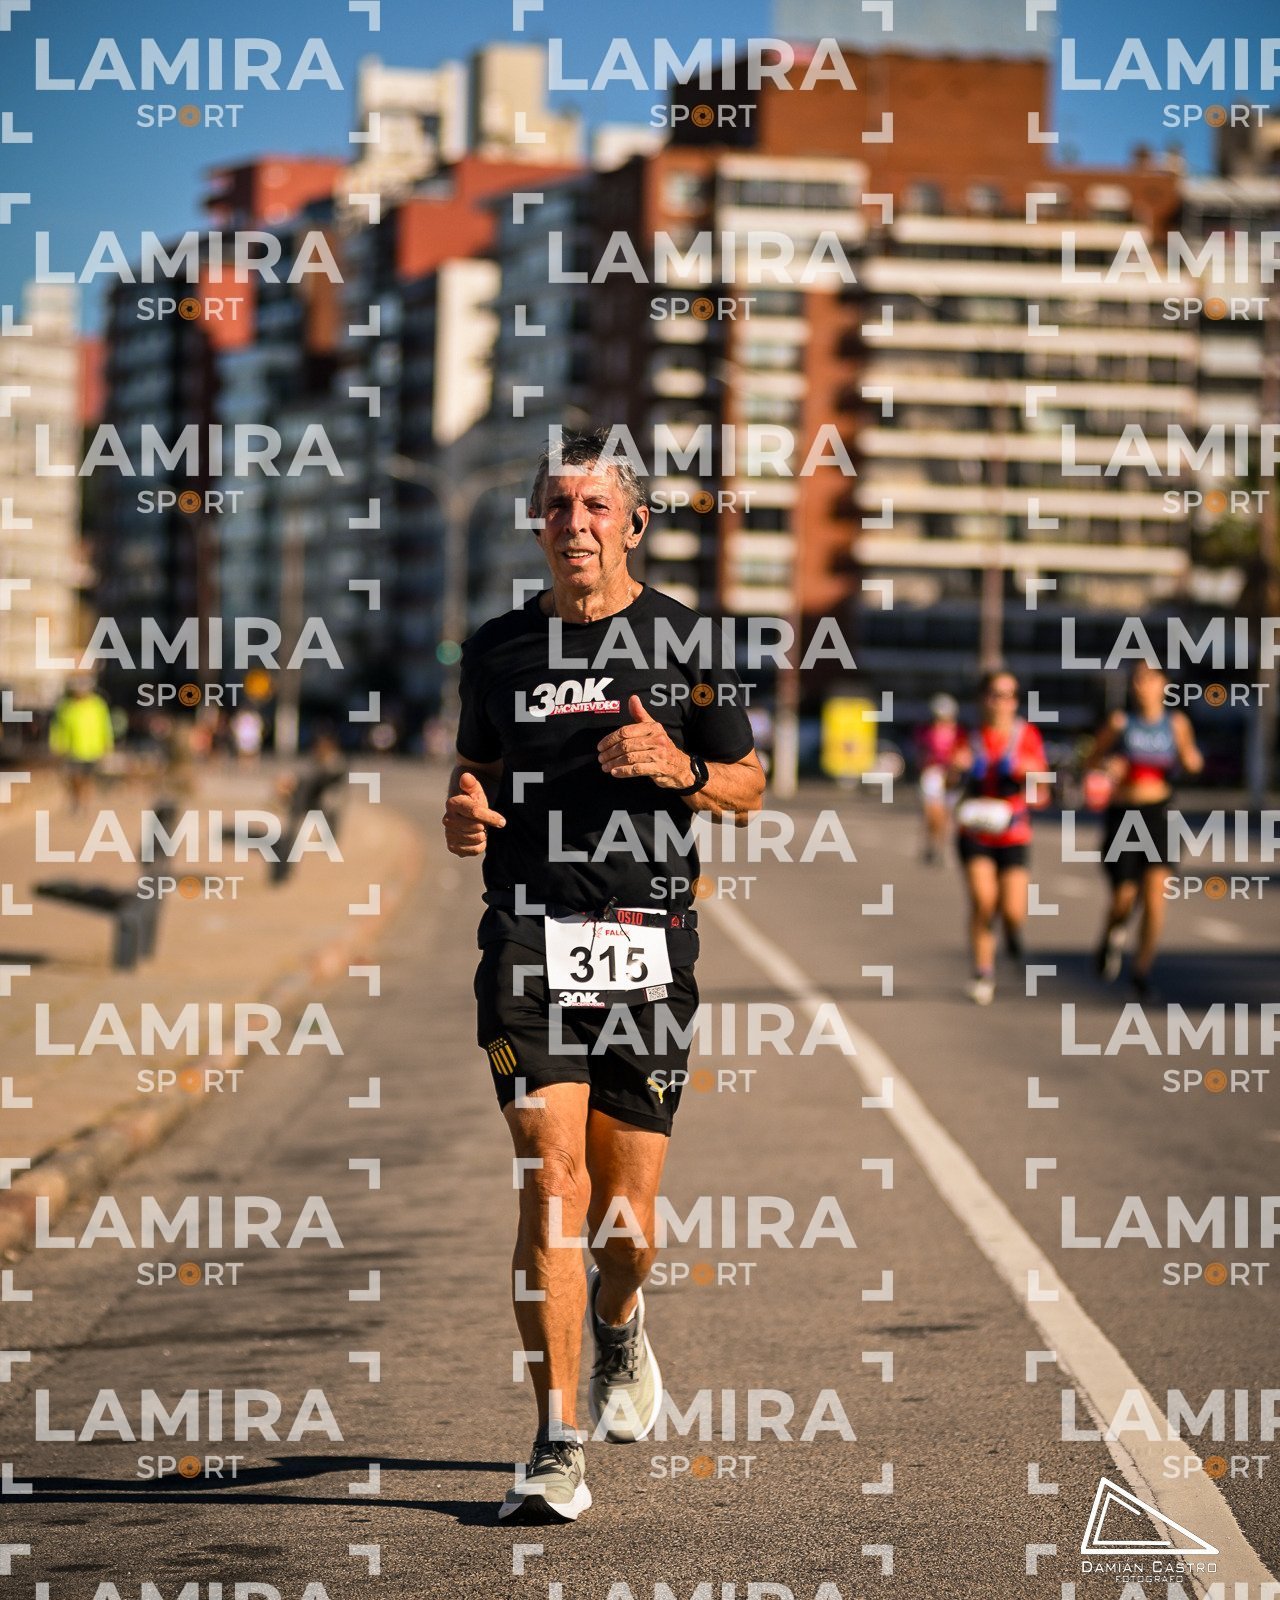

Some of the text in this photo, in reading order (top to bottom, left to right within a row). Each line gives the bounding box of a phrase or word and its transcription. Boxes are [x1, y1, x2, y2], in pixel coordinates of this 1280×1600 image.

[529, 677, 614, 718] 30K
[569, 945, 649, 983] 315
[558, 991, 600, 1007] 30K
